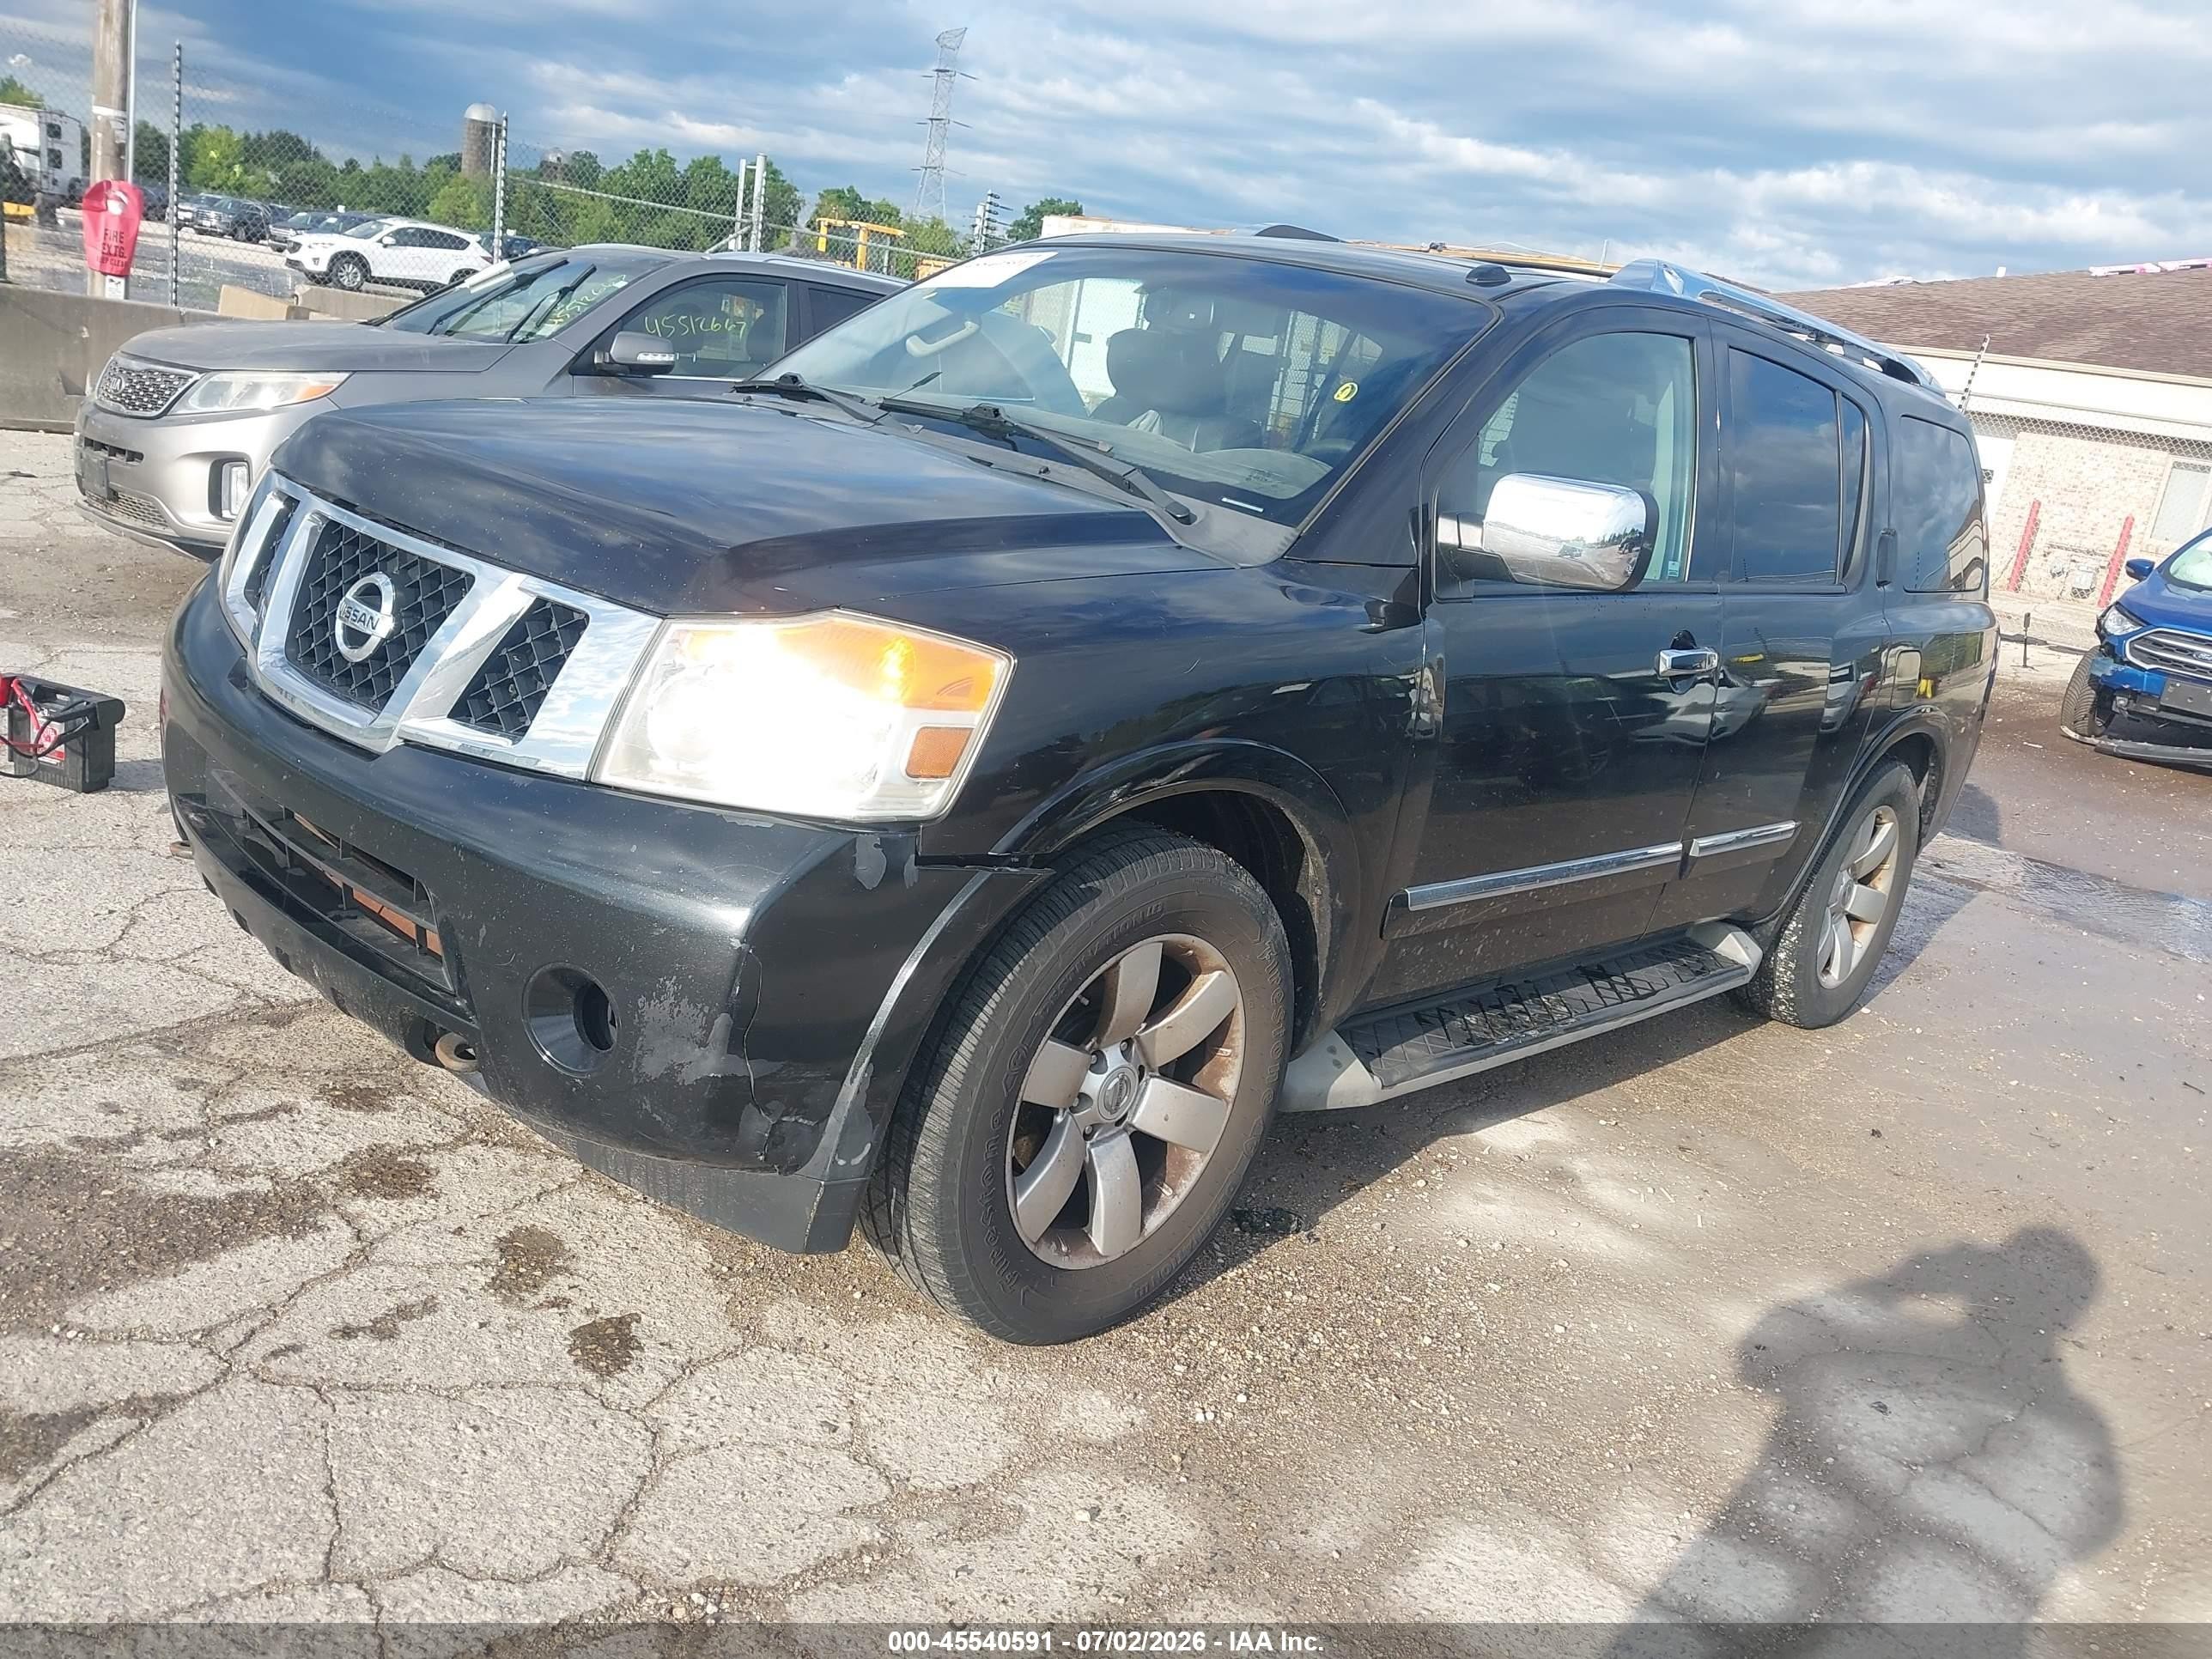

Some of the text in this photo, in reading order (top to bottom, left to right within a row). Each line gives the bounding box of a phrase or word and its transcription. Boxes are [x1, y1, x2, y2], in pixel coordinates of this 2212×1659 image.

[104, 228, 125, 244] FIRE
[338, 602, 380, 630] NISSAN
[1257, 939, 1286, 1106] Firestone
[977, 1108, 1022, 1293] Firestone
